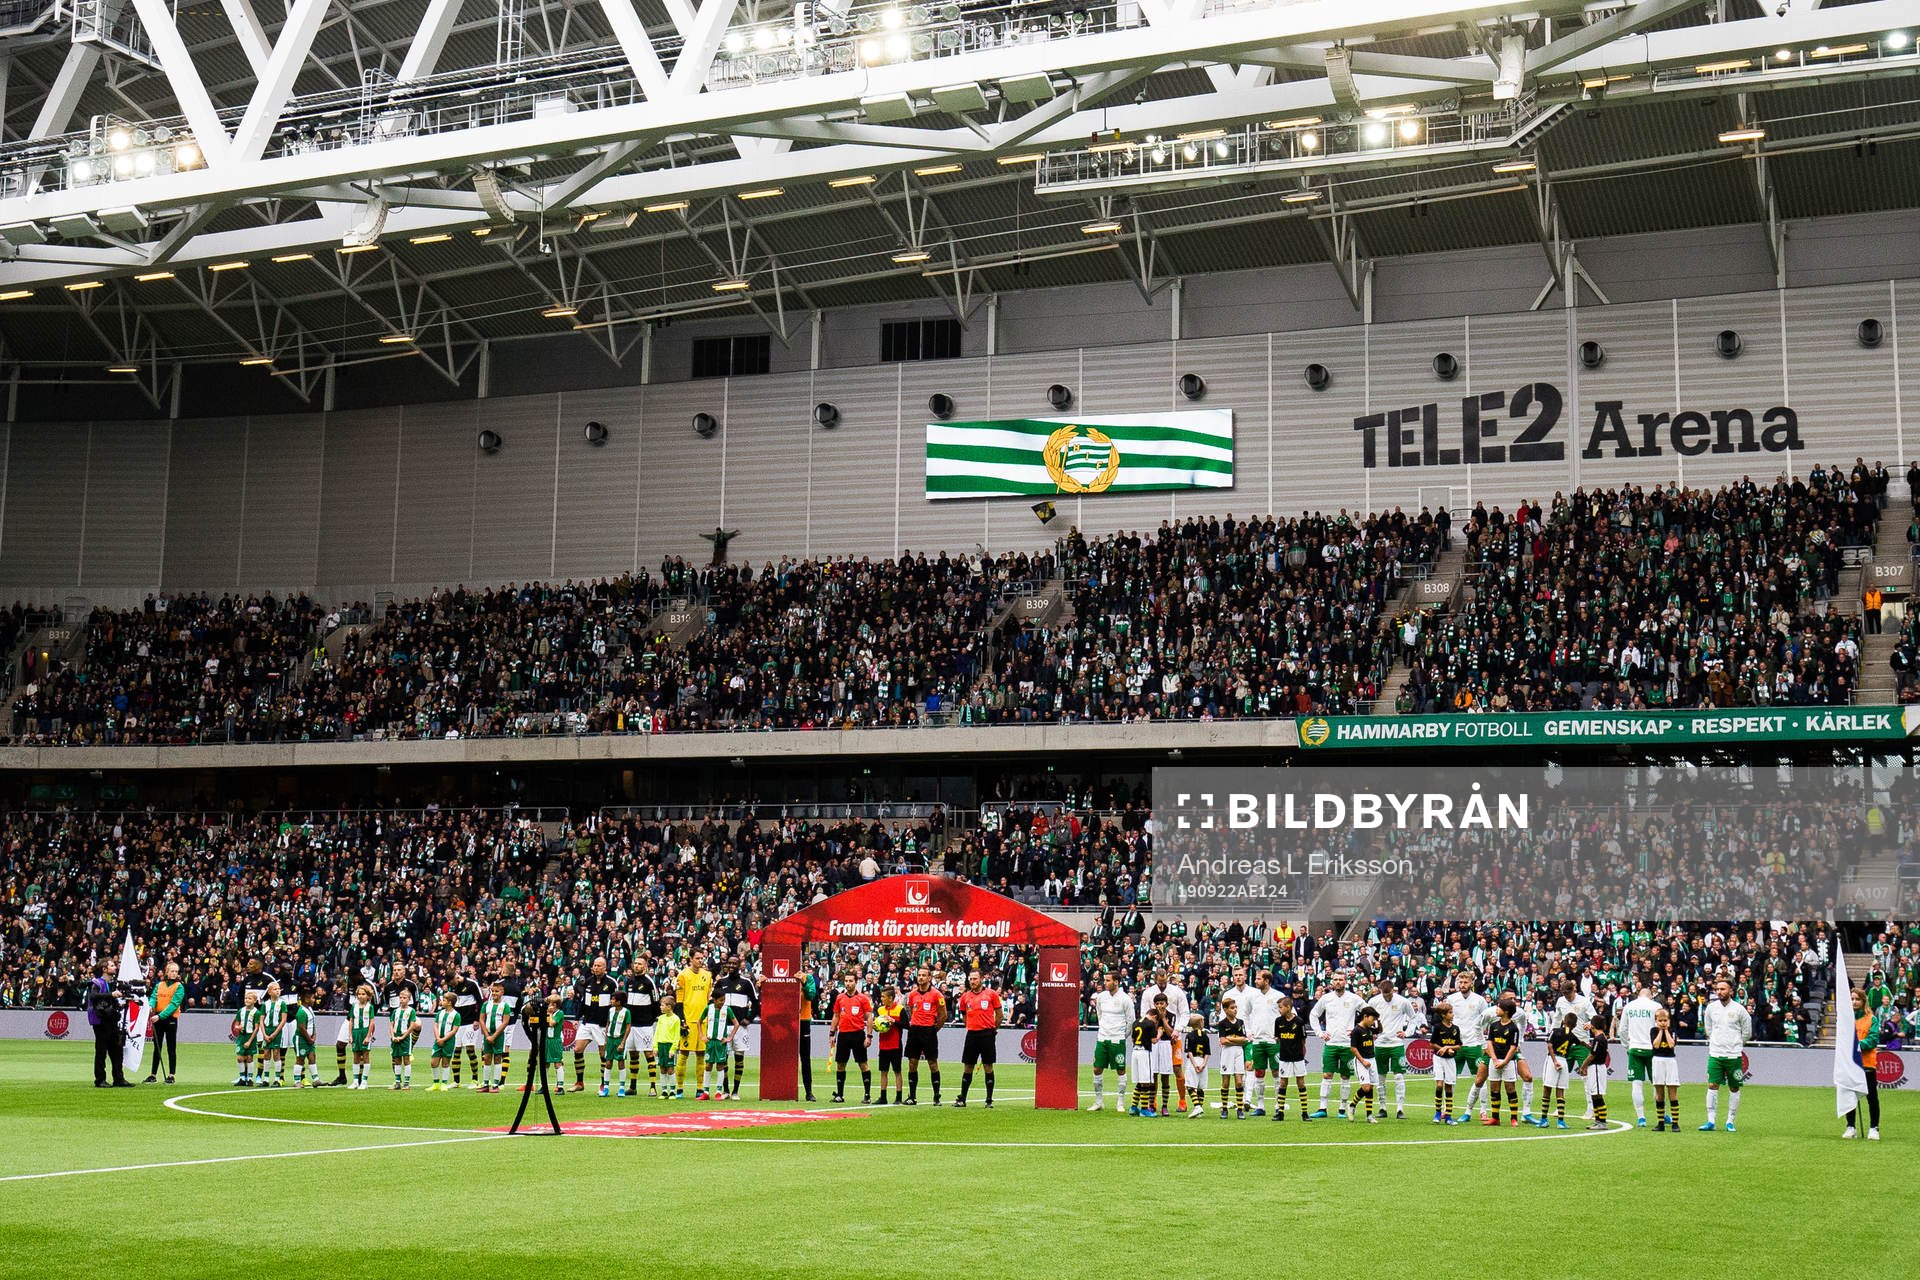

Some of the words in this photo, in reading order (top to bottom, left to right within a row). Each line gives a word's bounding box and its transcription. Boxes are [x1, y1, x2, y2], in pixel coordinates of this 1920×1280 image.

[1354, 382, 1565, 468] TELE2
[1582, 401, 1805, 459] Arena
[1875, 565, 1904, 577] B307
[1424, 583, 1449, 594] B308
[1026, 599, 1049, 610] B309
[49, 631, 70, 640] B312
[1337, 722, 1451, 740] HAMMARBY
[1455, 721, 1533, 738] FOTBOLL
[1544, 718, 1673, 737] GEMENSKAP
[1691, 716, 1787, 734] RESPEKT
[1805, 711, 1892, 731] KÄRLEK
[1340, 885, 1370, 897] A108
[1854, 887, 1889, 900] A107
[829, 919, 880, 937] Framåt
[882, 920, 904, 937] för
[907, 920, 954, 937] svensk
[957, 920, 1011, 938] fotboll!
[1628, 1009, 1651, 1018] BAJEN
[1134, 1026, 1143, 1045] 2
[1878, 1061, 1900, 1074] AFFE
